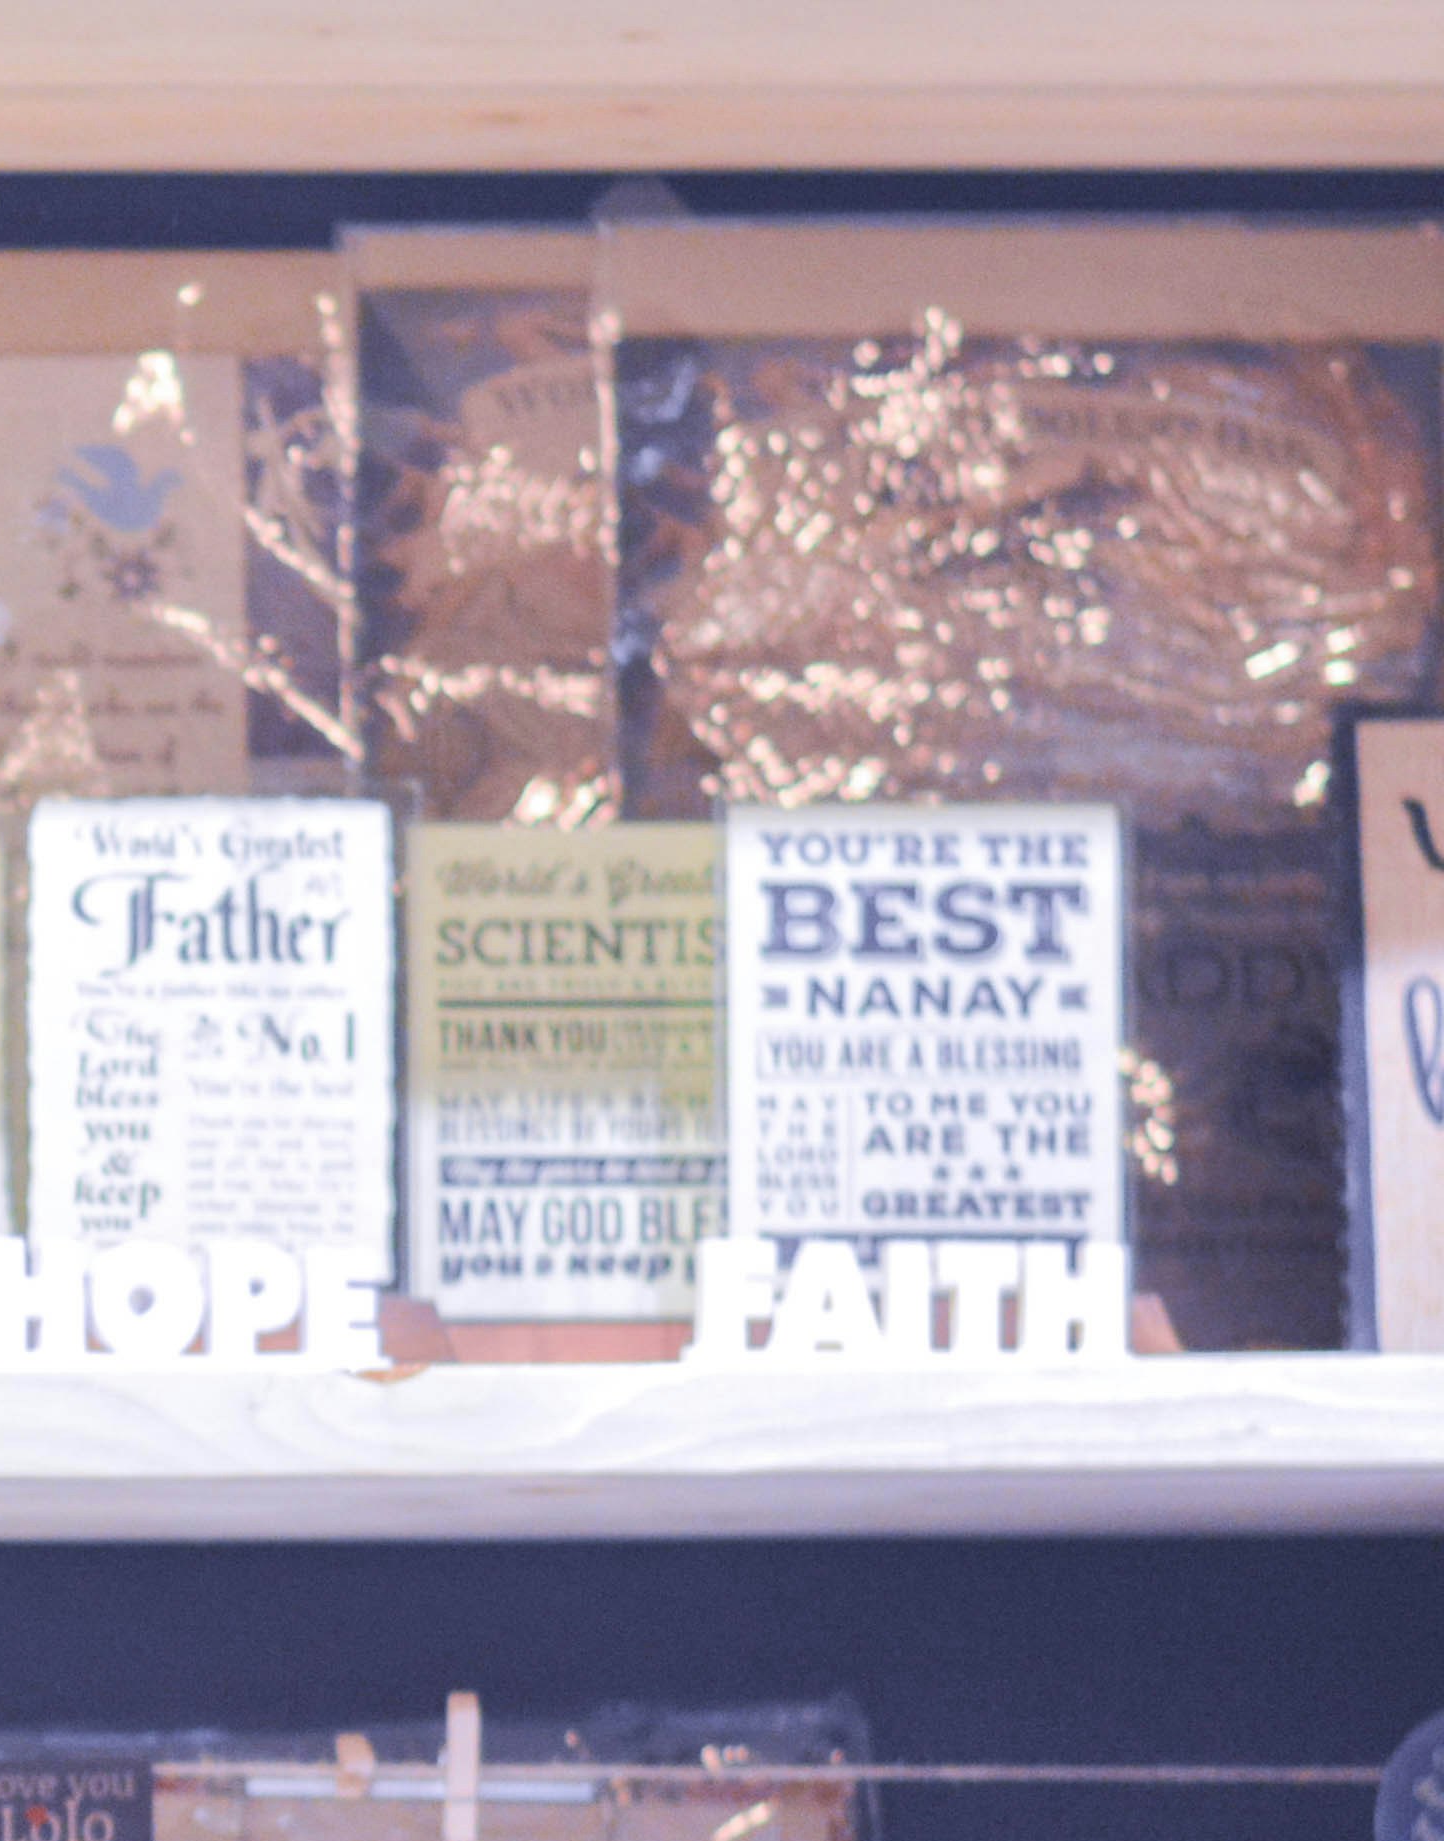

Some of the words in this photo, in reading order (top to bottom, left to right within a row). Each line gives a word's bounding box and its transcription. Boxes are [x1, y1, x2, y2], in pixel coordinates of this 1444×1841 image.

[759, 831, 961, 866] YOU'RE
[977, 831, 1089, 866] THE
[68, 868, 352, 980] Father
[758, 878, 1088, 964] BEST
[435, 914, 726, 968] SCIENTIS
[805, 976, 1043, 1018] NANAY
[438, 1019, 539, 1055] THANK
[546, 1019, 608, 1055] YOU
[768, 1037, 825, 1069] YOU
[838, 1037, 897, 1069] ARE
[936, 1037, 1082, 1070] BLESSING
[77, 1051, 161, 1080] Lord
[74, 1082, 161, 1109] bless
[863, 1090, 913, 1117] TO
[928, 1090, 986, 1117] ME
[1008, 1090, 1094, 1117] YOU
[862, 1124, 965, 1157] ARE
[994, 1124, 1091, 1157] THE
[72, 1169, 164, 1221] keep
[861, 1190, 1091, 1220] GREATEST
[438, 1196, 530, 1247] MAY
[541, 1195, 624, 1248] GOD
[695, 1237, 1130, 1357] FAITH
